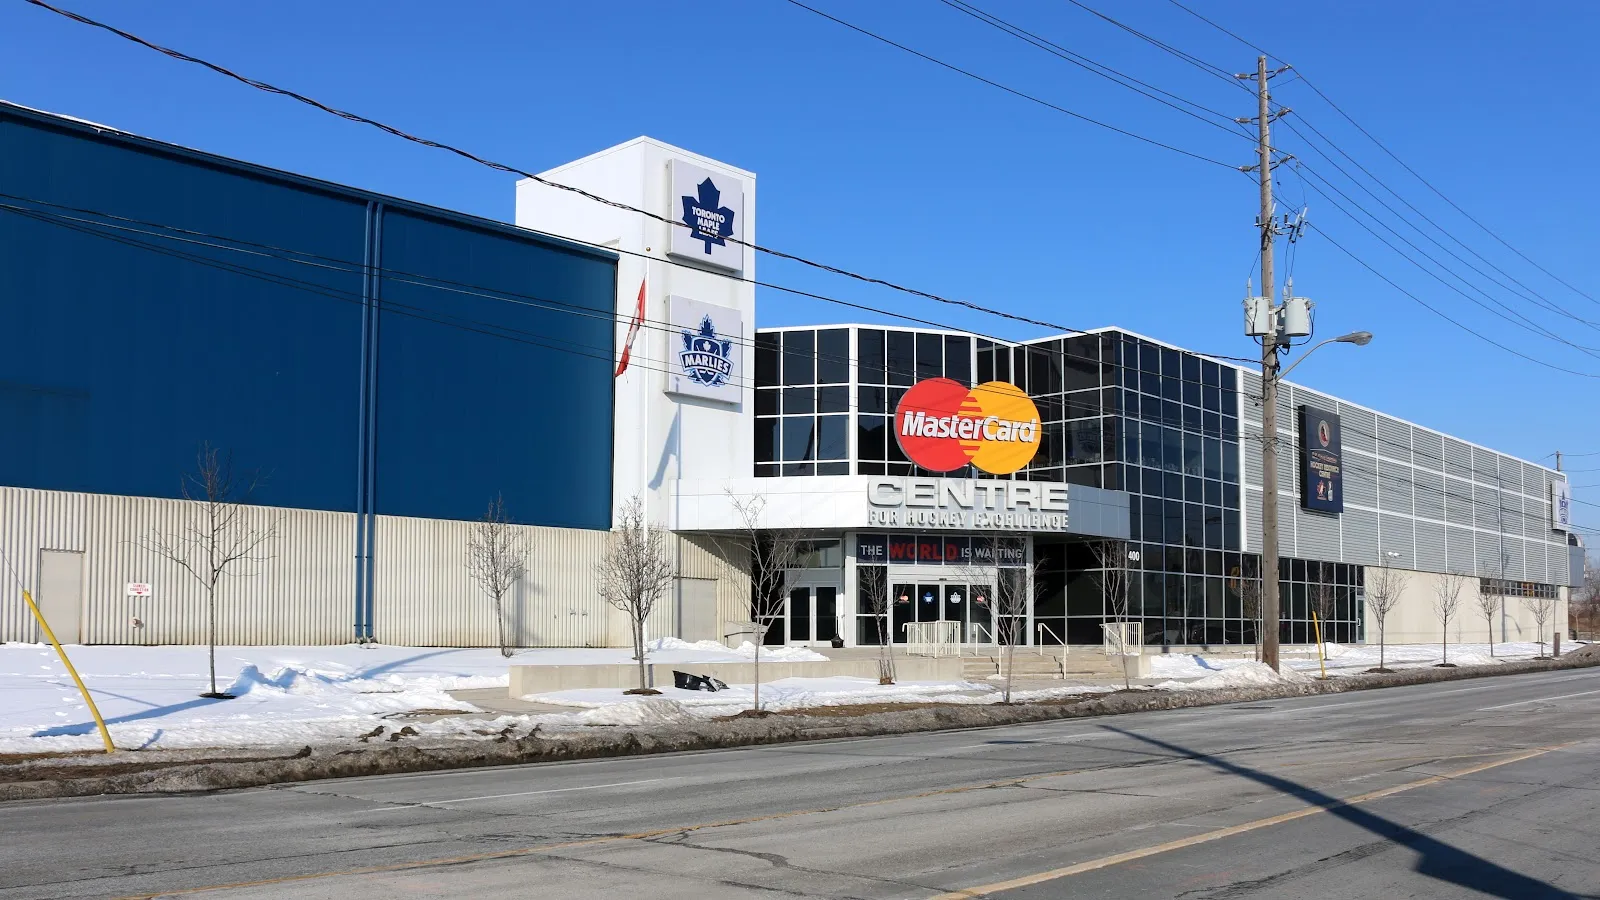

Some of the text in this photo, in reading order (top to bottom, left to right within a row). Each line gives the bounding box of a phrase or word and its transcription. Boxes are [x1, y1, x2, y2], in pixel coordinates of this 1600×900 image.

[692, 206, 725, 223] TORONTO
[697, 217, 720, 231] MAPLE
[684, 354, 729, 373] MARLIES
[902, 411, 1036, 443] MasterCard
[867, 478, 1069, 511] CENTRE
[869, 510, 1069, 530] FOR HOCKEY EXCELLENCE
[860, 543, 1023, 561] THE WORLD IS WAITING
[1128, 550, 1140, 561] 400
